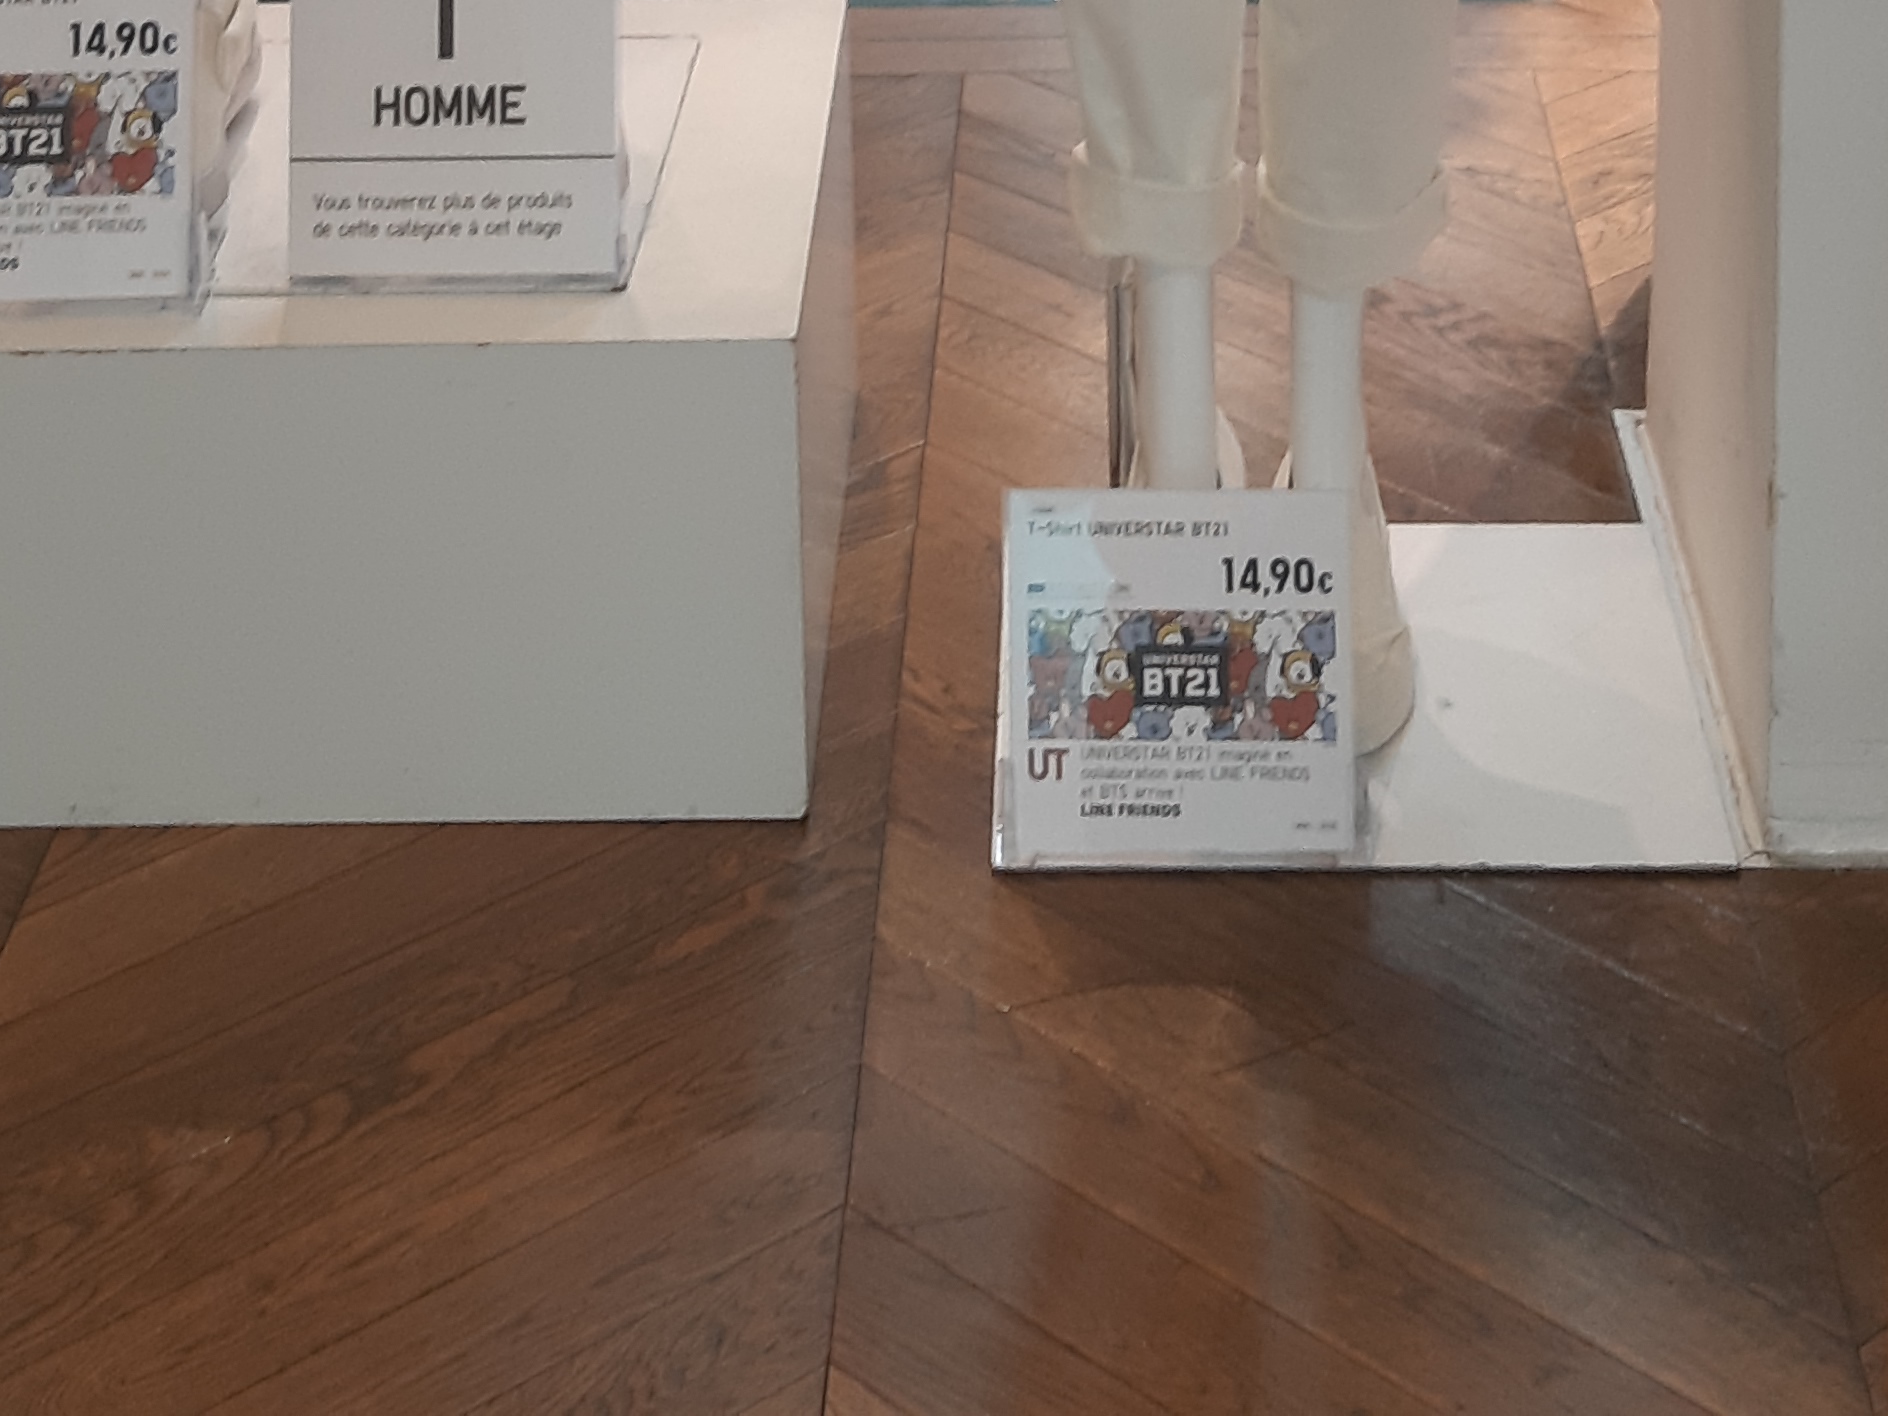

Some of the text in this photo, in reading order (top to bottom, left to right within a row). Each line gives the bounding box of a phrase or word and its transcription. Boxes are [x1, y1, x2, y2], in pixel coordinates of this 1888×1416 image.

[373, 83, 527, 127] HOMME
[313, 190, 574, 214] Vous trouverez plus de produits
[313, 220, 332, 239] de
[338, 219, 380, 238] cette
[1088, 520, 1186, 537] UNIVERSTAR
[1191, 520, 1229, 537] BT21
[1142, 667, 1221, 699] BT21
[1027, 746, 1070, 781] UT
